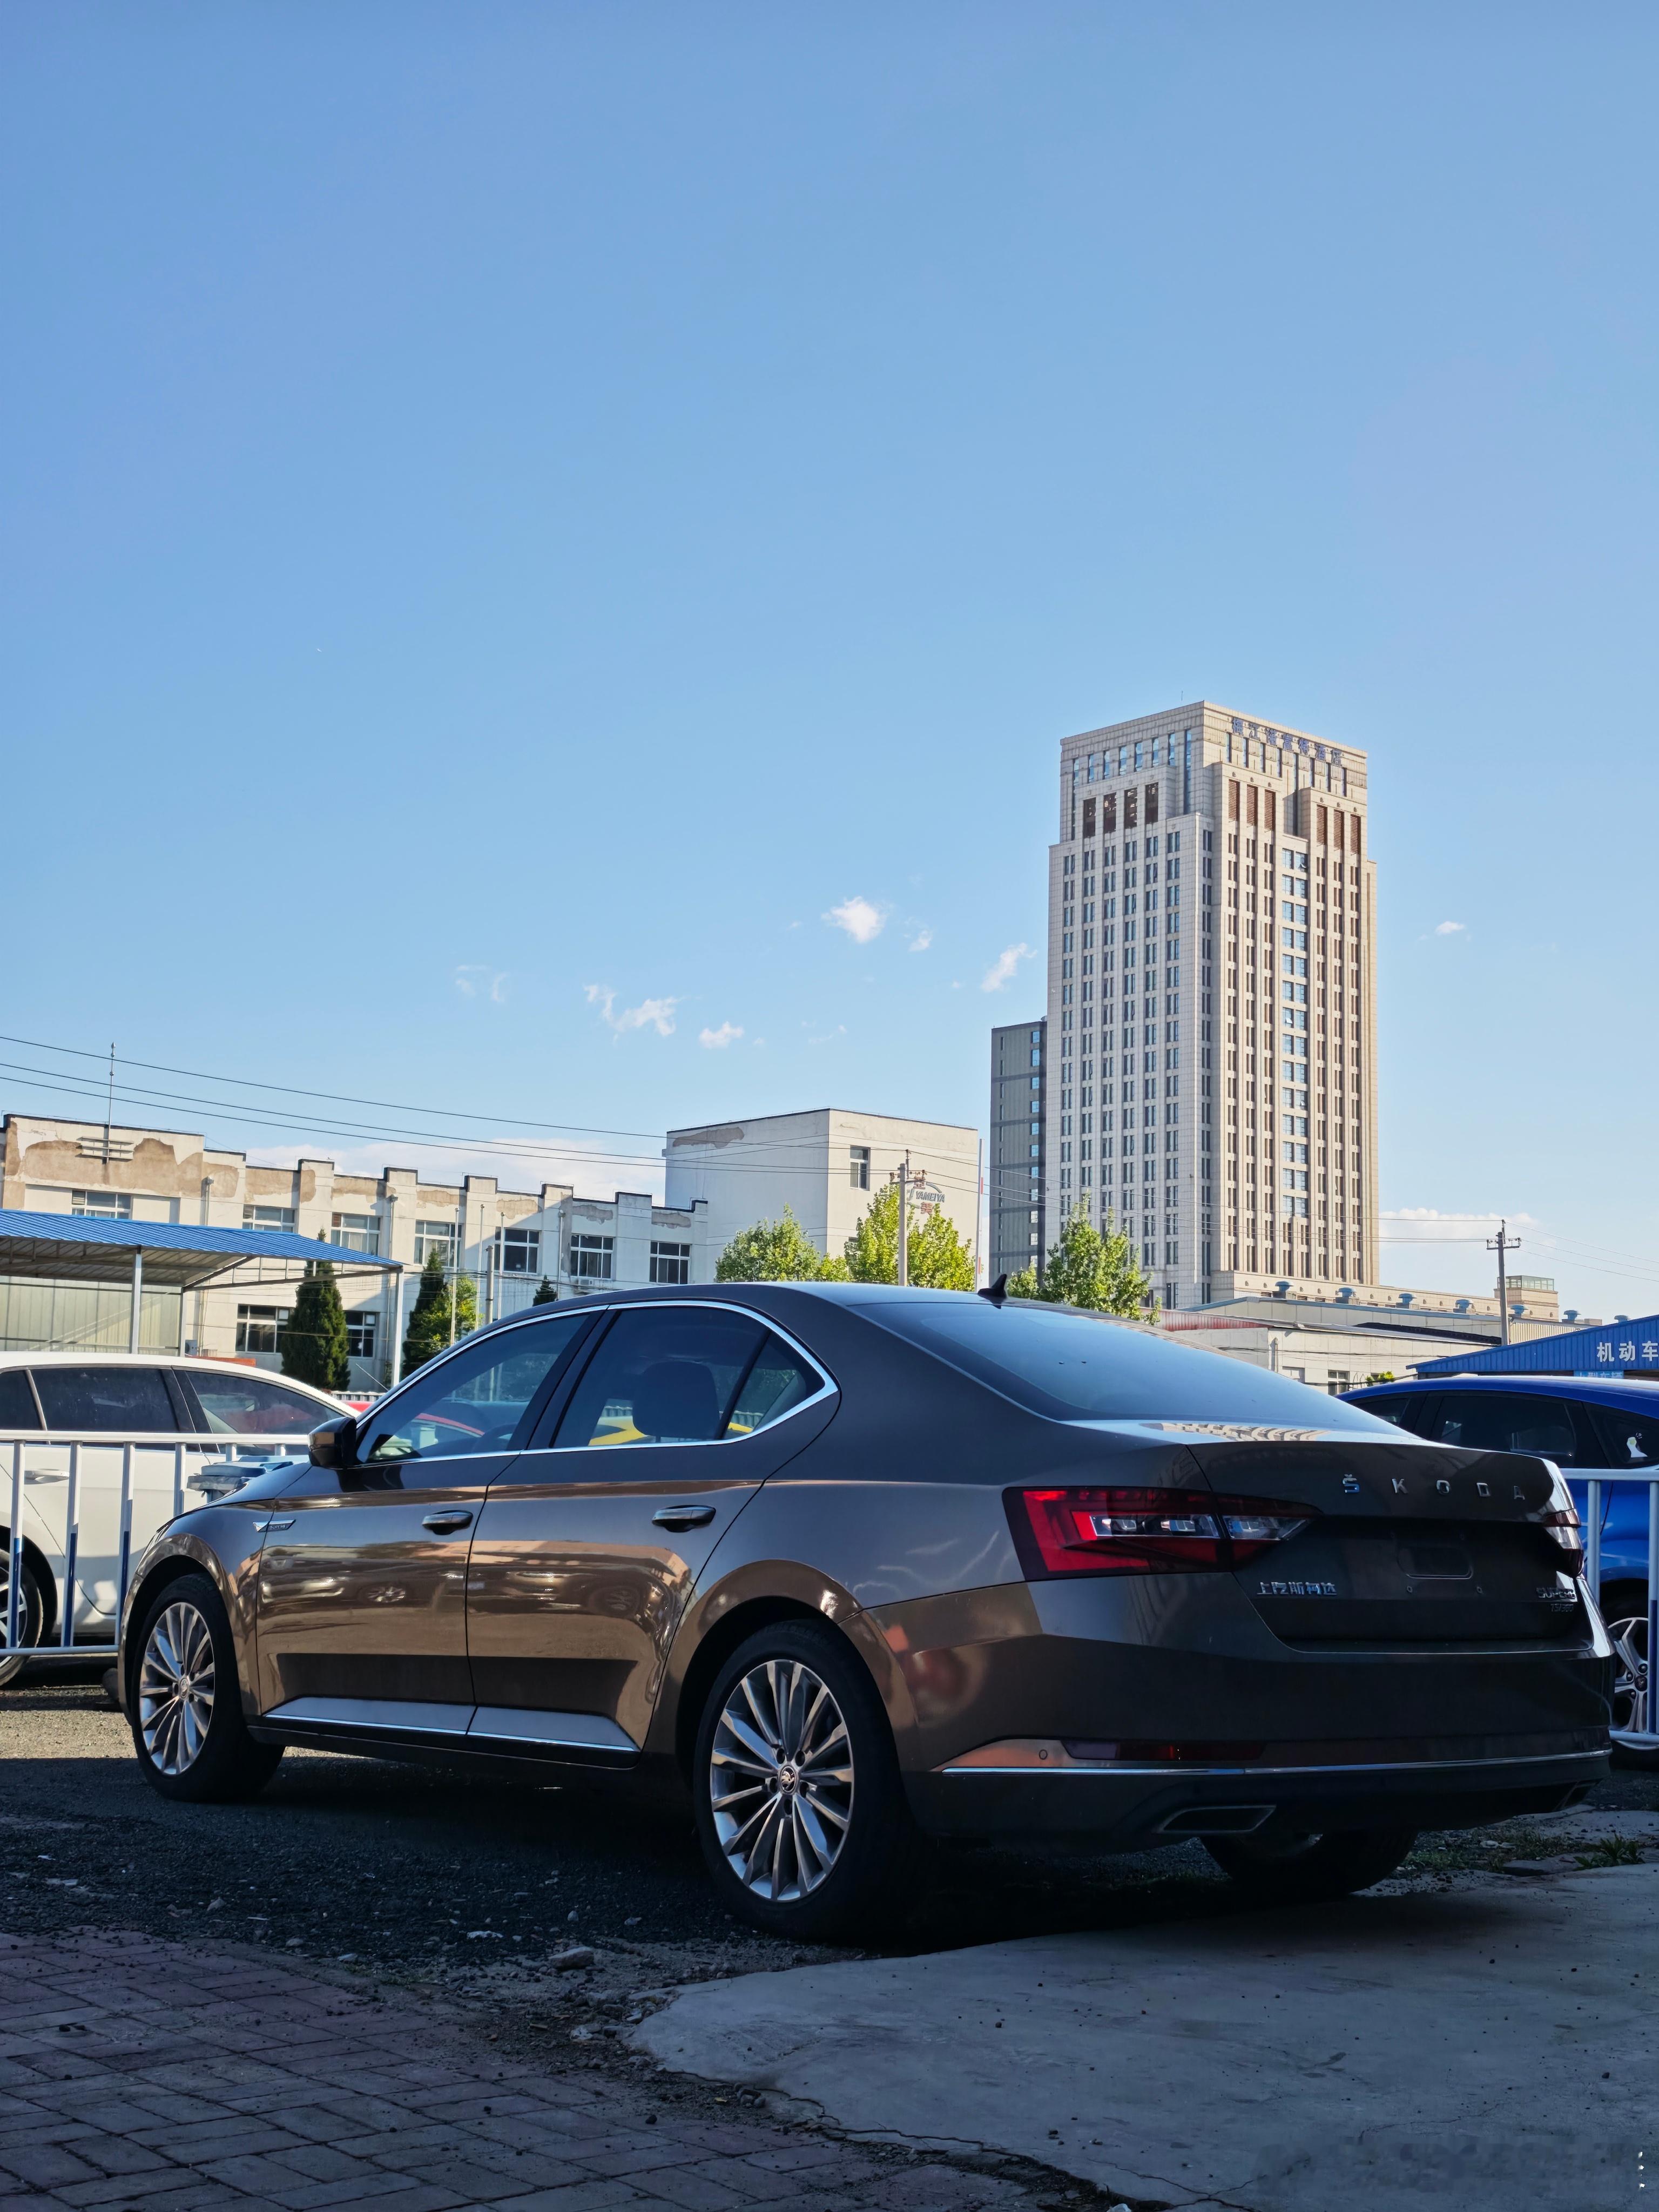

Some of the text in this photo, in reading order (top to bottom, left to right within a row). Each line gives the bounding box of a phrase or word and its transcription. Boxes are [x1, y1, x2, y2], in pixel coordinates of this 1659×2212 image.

[1596, 1340, 1659, 1363] 机动车
[1257, 1582, 1337, 1595] 上汽斯柯达
[1536, 1587, 1576, 1599] SUPERB
